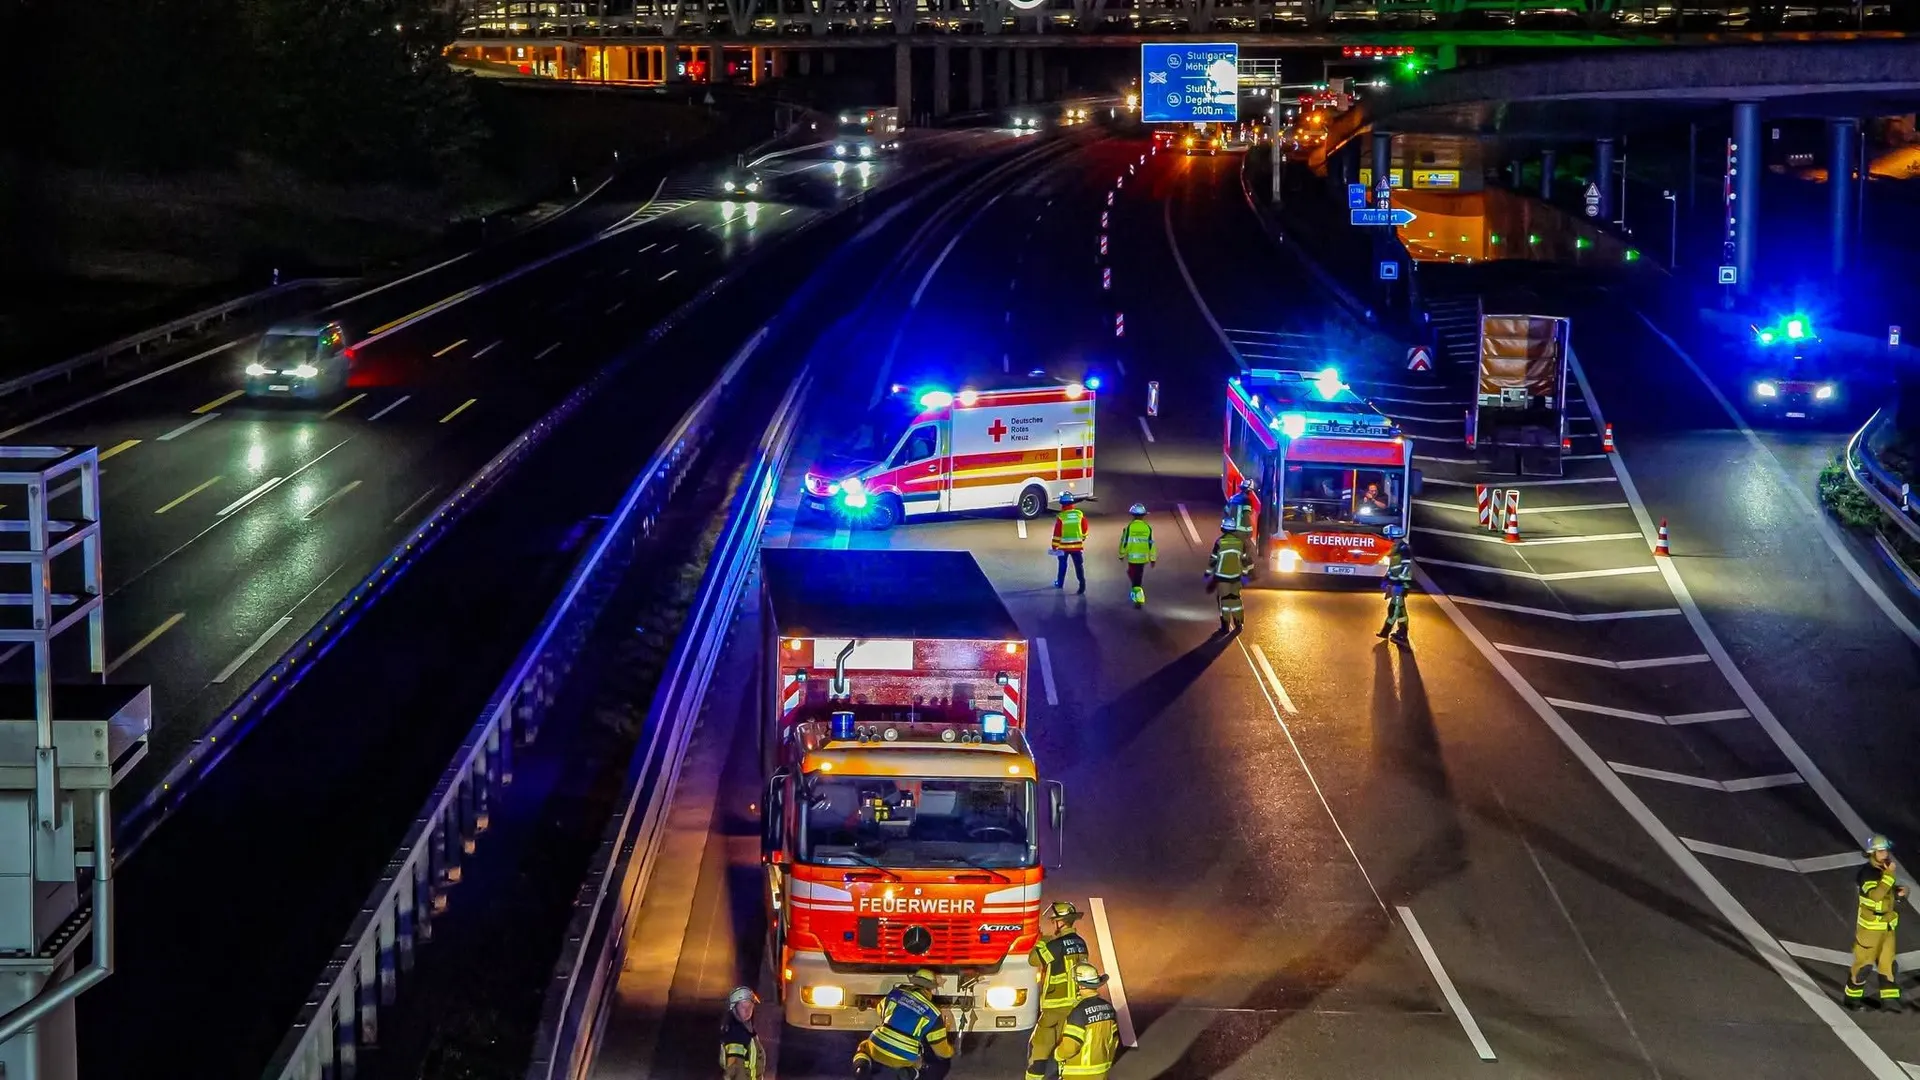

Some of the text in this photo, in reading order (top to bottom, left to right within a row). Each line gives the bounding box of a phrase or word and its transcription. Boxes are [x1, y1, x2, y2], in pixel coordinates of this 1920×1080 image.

[1192, 106, 1224, 115] 2000 m
[1011, 417, 1043, 425] Deutsches
[1307, 534, 1375, 548] FEUERWEHR
[859, 897, 976, 914] FEUERWEHR
